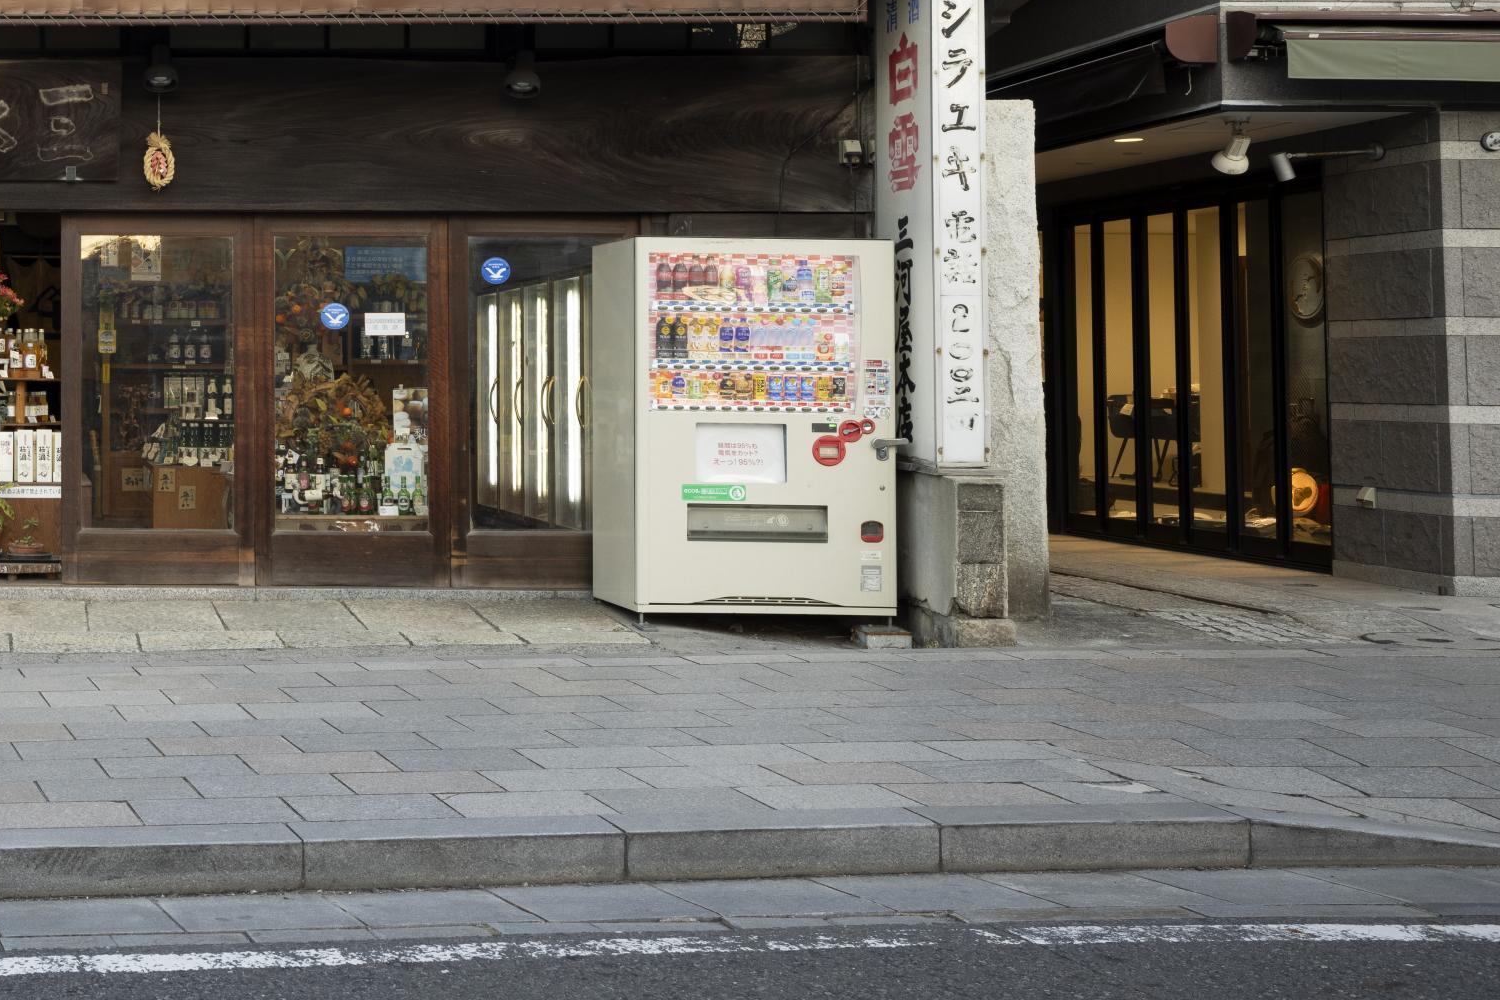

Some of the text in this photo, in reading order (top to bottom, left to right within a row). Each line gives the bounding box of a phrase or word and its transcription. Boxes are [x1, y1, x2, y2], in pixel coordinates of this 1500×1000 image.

[888, 31, 923, 194] 白雪
[895, 215, 916, 443] 三河屋本店
